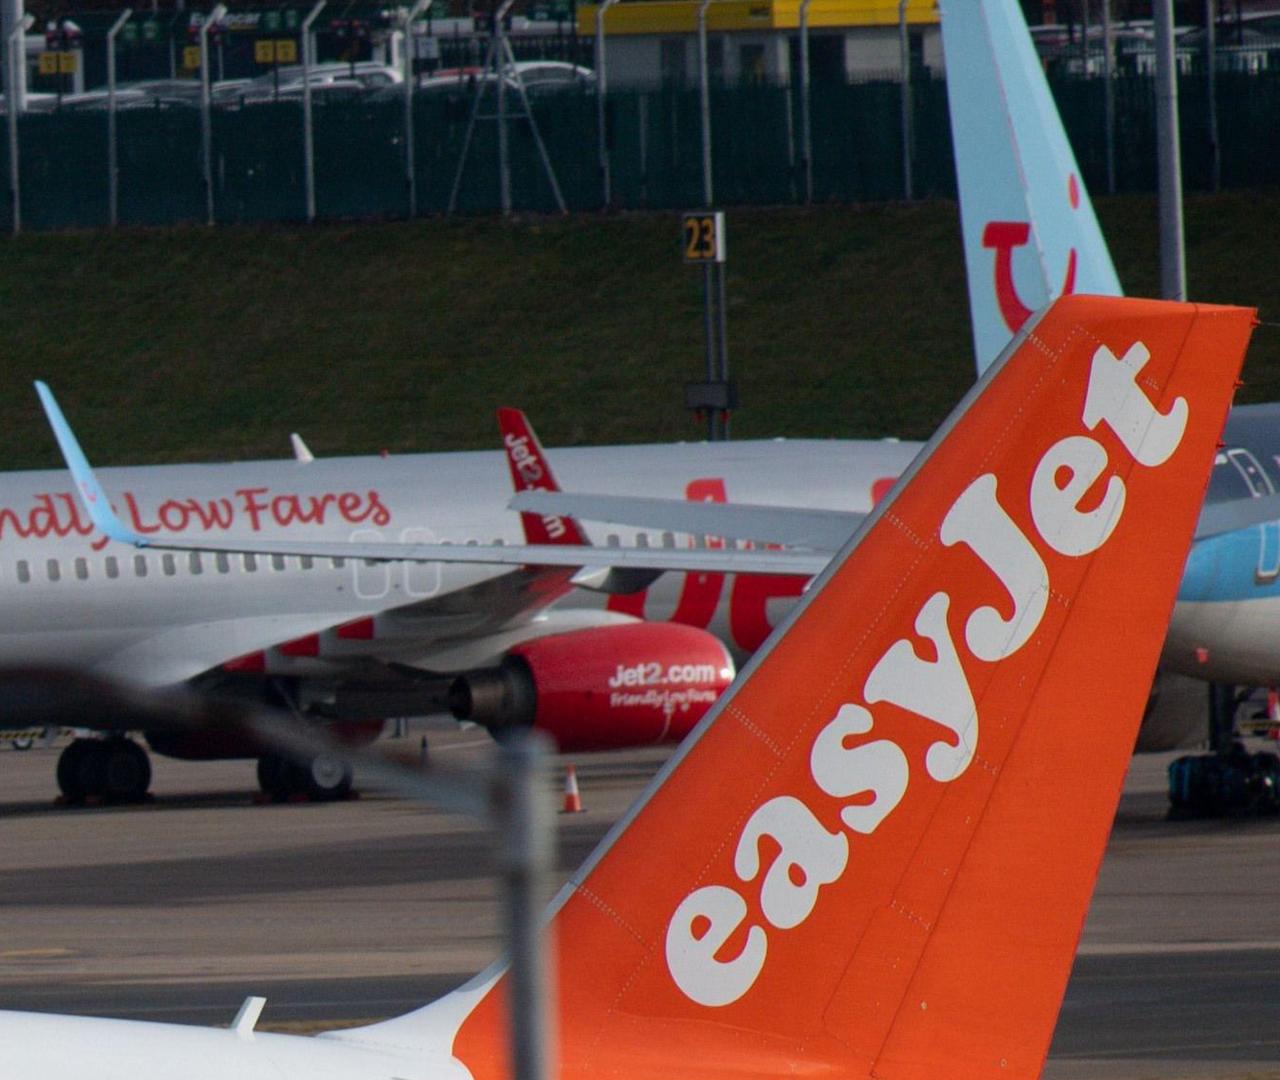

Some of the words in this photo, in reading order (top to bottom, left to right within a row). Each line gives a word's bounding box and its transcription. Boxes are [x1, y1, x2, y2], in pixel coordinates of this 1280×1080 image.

[687, 218, 716, 258] 23
[236, 486, 391, 531] Fares
[608, 662, 716, 688] Jet2.com
[666, 341, 1189, 1007] easyJet
